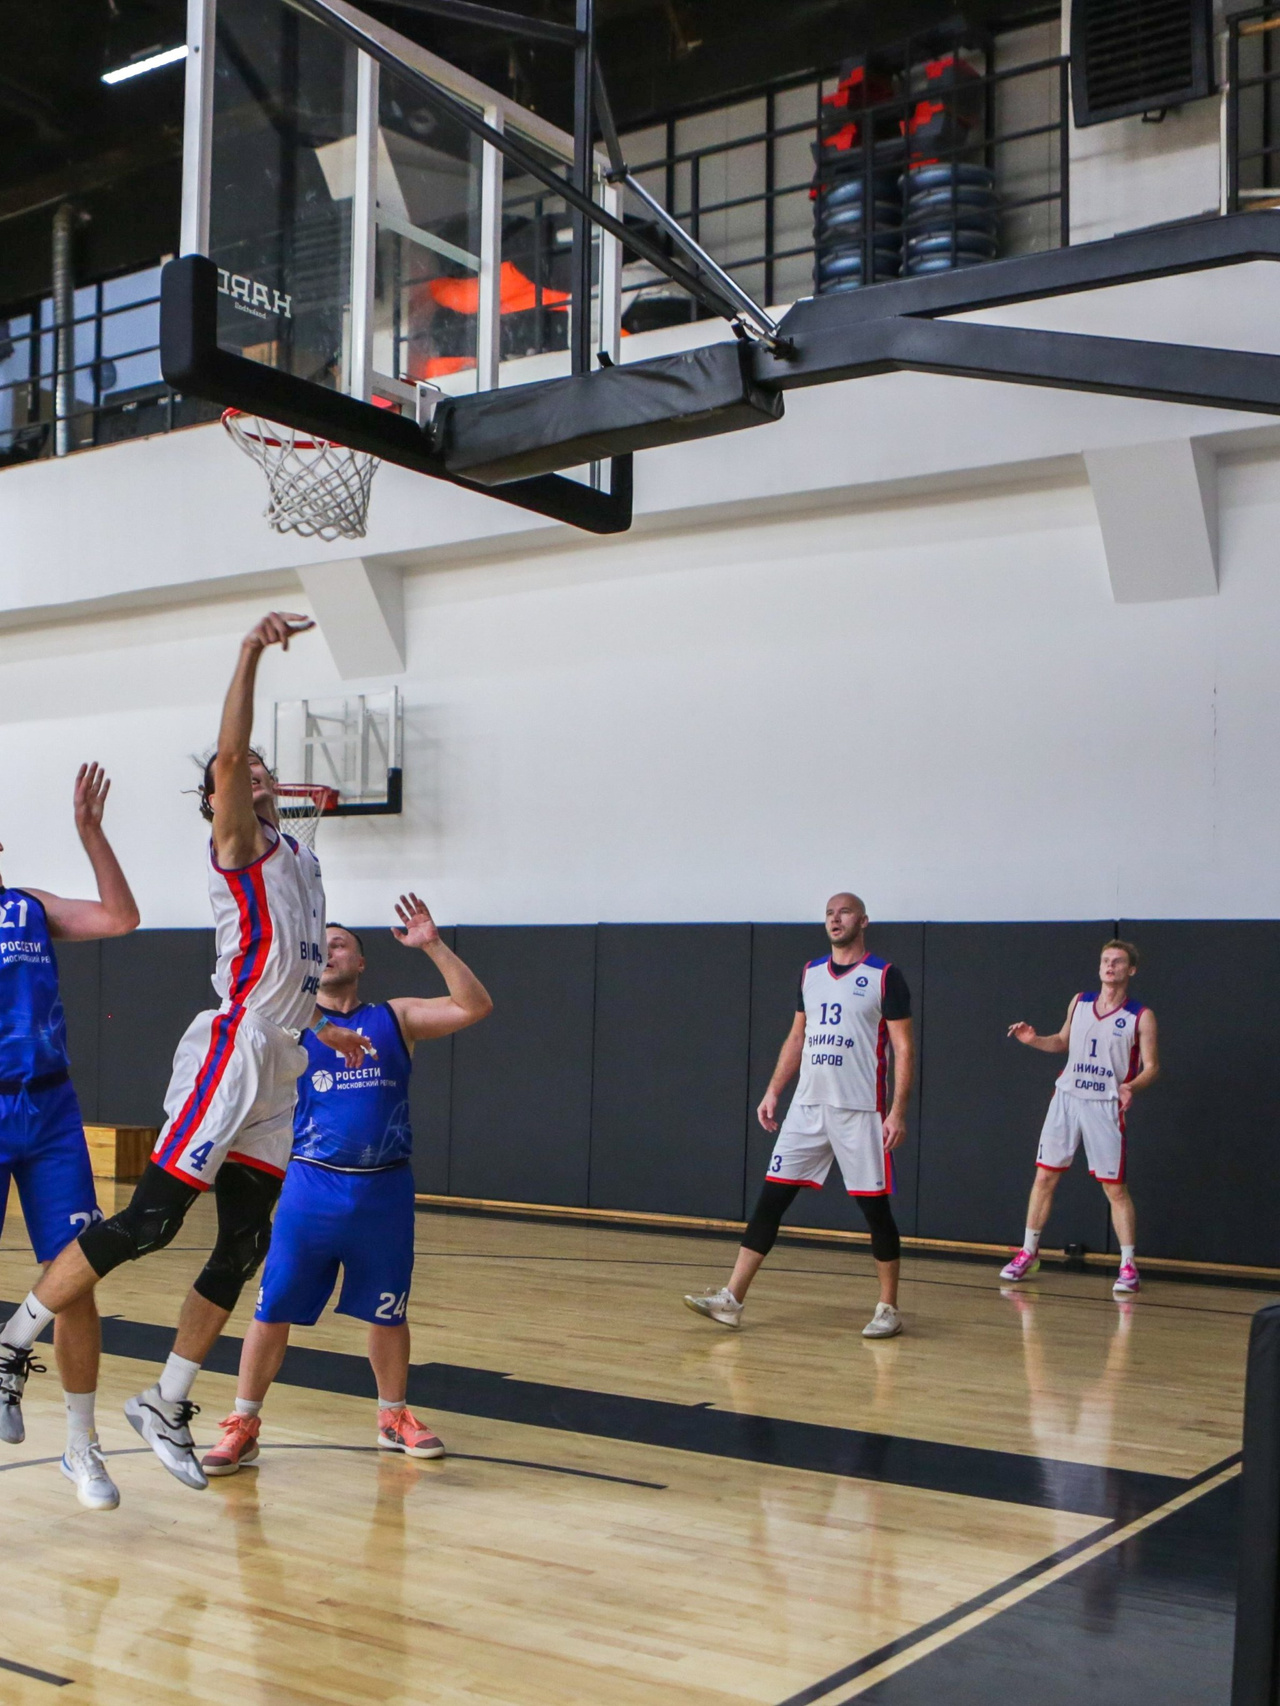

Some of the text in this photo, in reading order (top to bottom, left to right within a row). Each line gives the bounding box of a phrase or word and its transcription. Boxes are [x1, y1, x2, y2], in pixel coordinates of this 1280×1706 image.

[819, 1002, 842, 1025] 13
[1089, 1038, 1098, 1058] 1
[811, 1053, 844, 1067] САРОВ
[336, 1067, 381, 1082] РОССЕТИ
[1075, 1078, 1106, 1093] САРОВ
[189, 1140, 215, 1172] 4
[375, 1291, 406, 1319] 24
